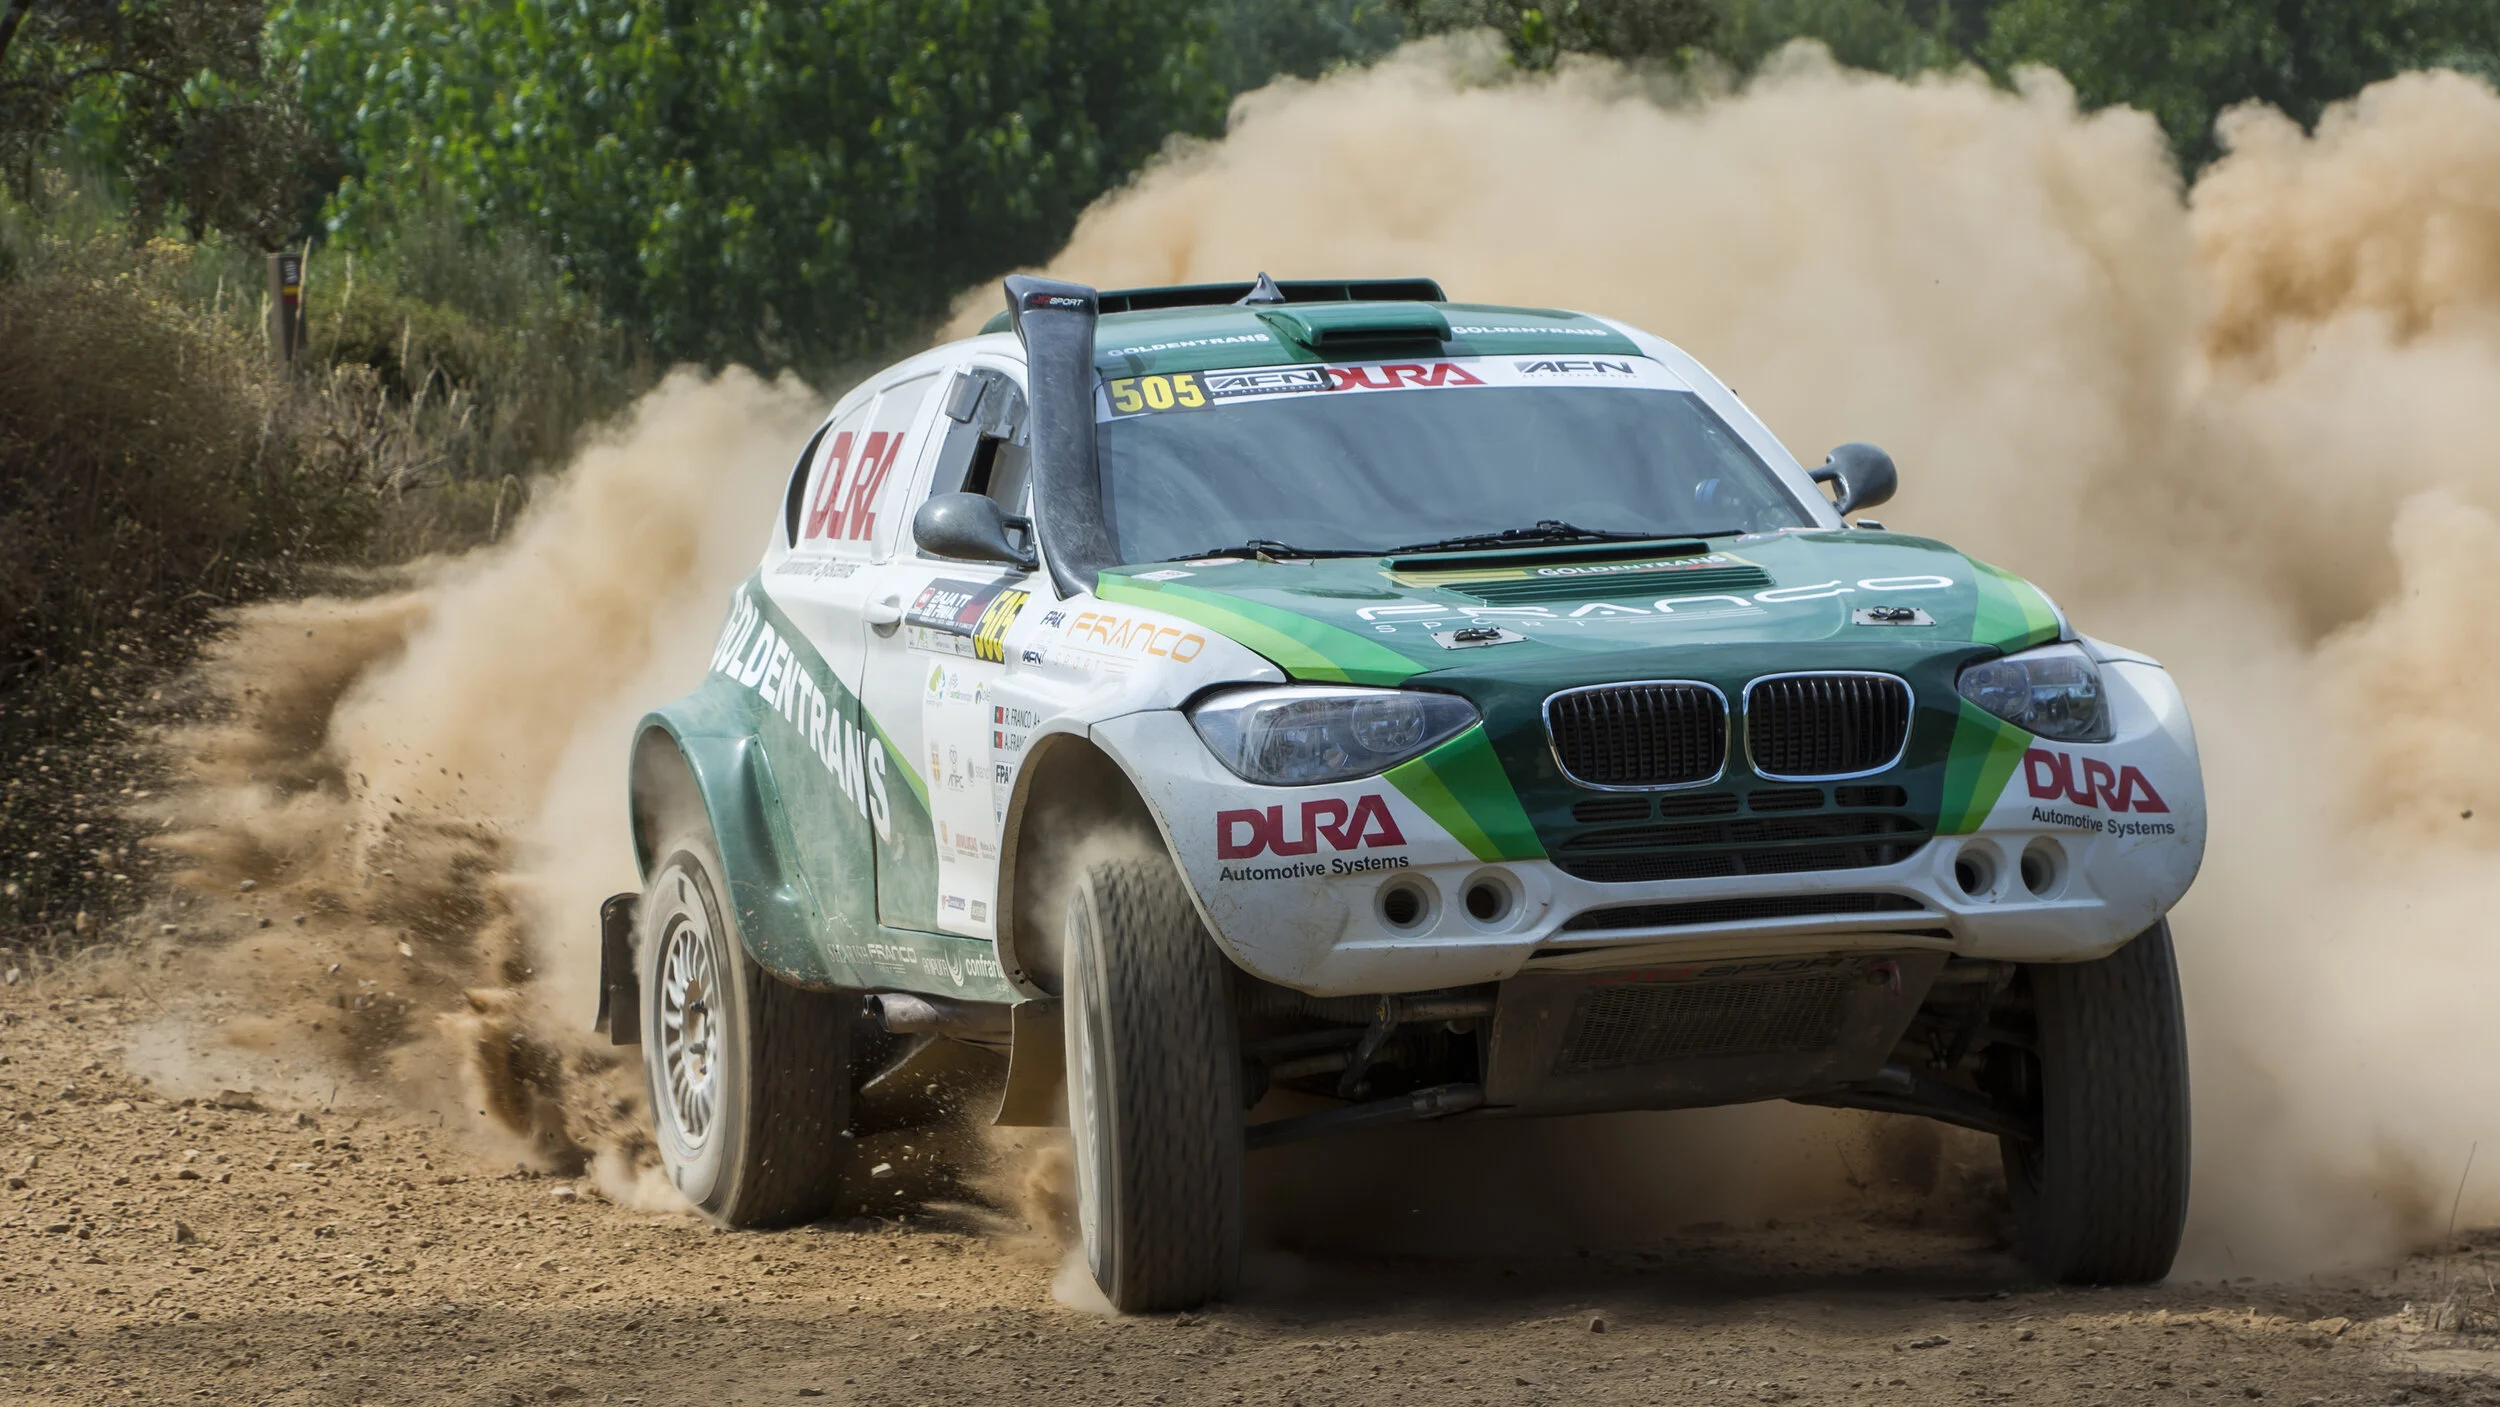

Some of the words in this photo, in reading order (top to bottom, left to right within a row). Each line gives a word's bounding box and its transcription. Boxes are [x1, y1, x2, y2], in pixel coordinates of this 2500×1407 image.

[1107, 333, 1270, 357] GOLDENTRANS
[1451, 326, 1608, 337] GOLDENTRANS
[1212, 371, 1319, 390] AFN
[1523, 360, 1634, 374] AFN
[1111, 375, 1206, 413] 505
[1537, 553, 1728, 577] GOLDENTRANS
[1356, 575, 1953, 622] FRANCO
[973, 590, 1031, 662] 505
[1066, 611, 1206, 663] FRANCO
[996, 764, 1012, 784] FPA
[2023, 748, 2171, 813] DURA
[1217, 794, 1408, 860] DURA
[2031, 806, 2103, 832] Automotive
[2107, 819, 2175, 838] Systems
[1219, 862, 1326, 882] Automotive
[1331, 855, 1409, 875] Systems
[867, 943, 918, 964] FRANCO
